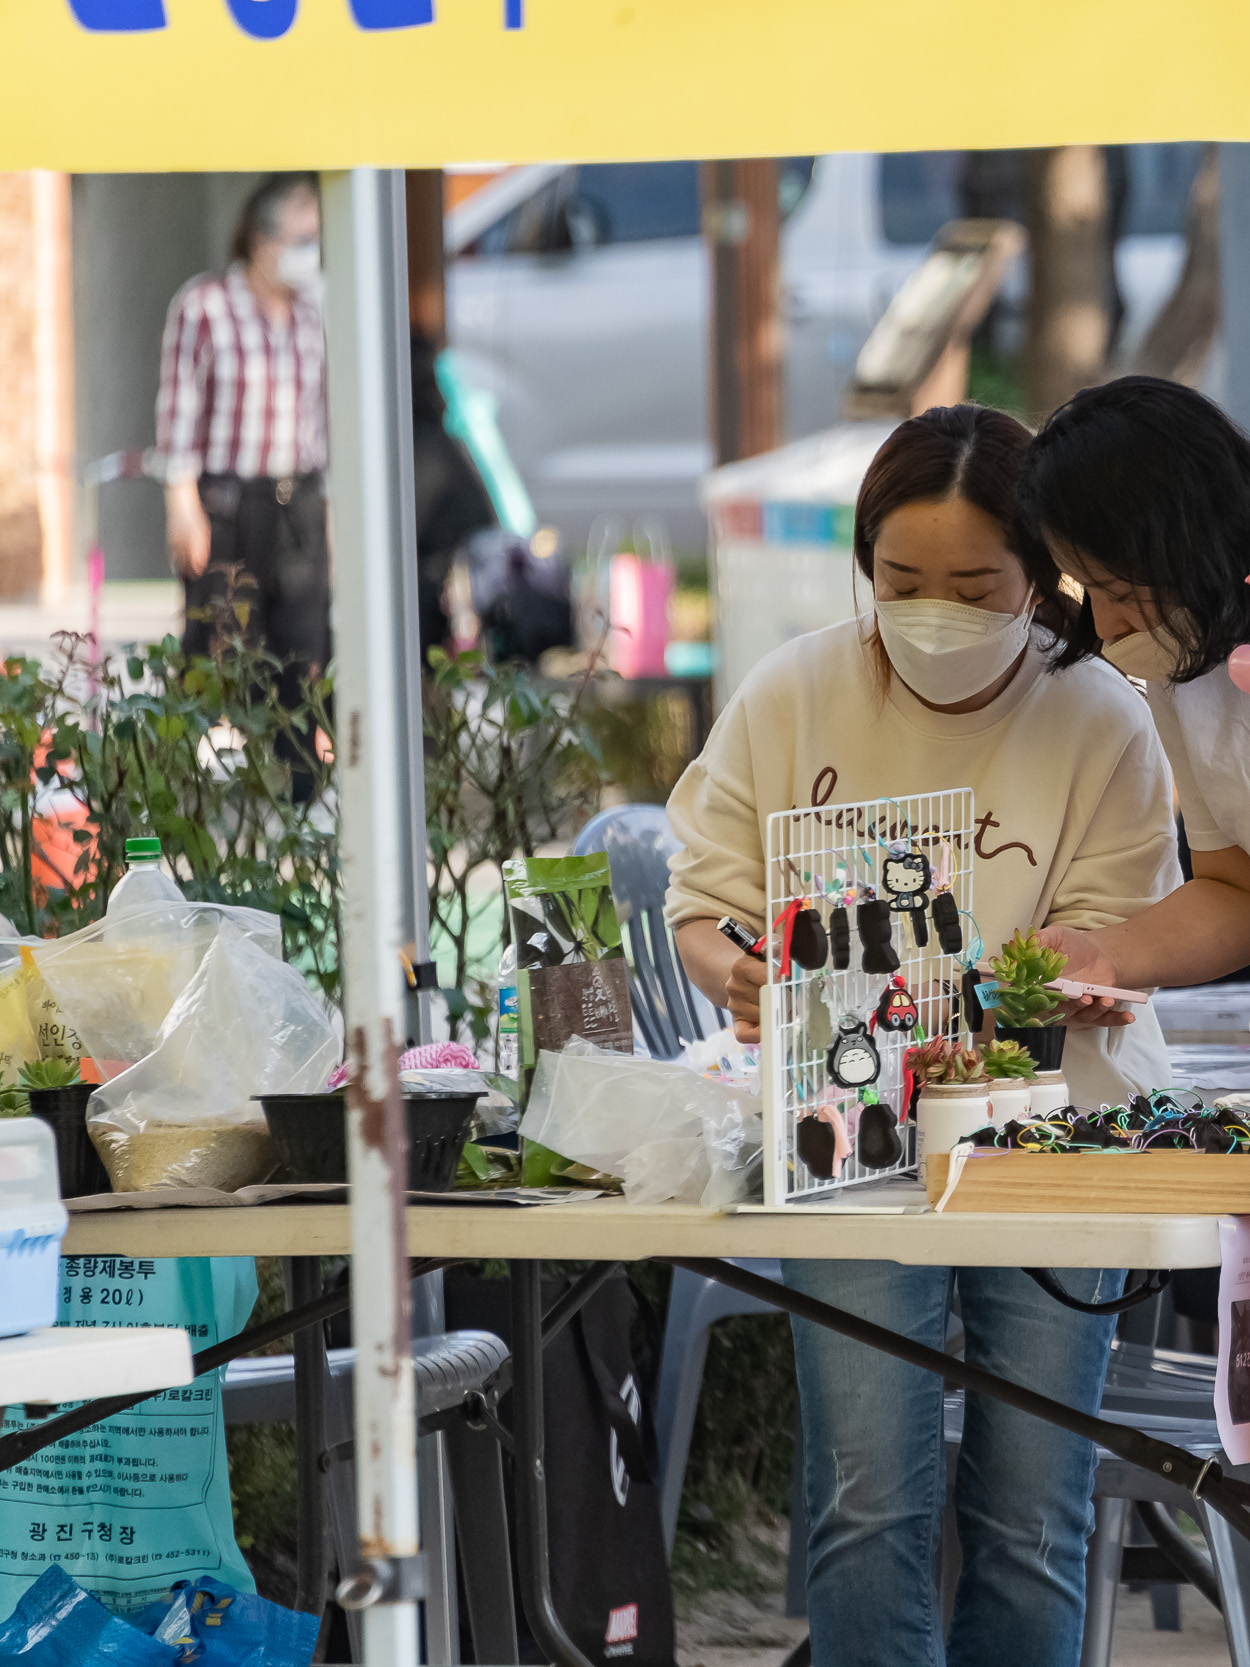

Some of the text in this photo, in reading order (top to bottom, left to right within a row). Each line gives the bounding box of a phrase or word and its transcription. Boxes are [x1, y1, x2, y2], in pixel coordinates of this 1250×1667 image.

[65, 1258, 157, 1280] 종량제봉투
[108, 1426, 146, 1437] 지역에서만
[12, 1481, 33, 1492] 구입한
[21, 1551, 46, 1562] 청소과
